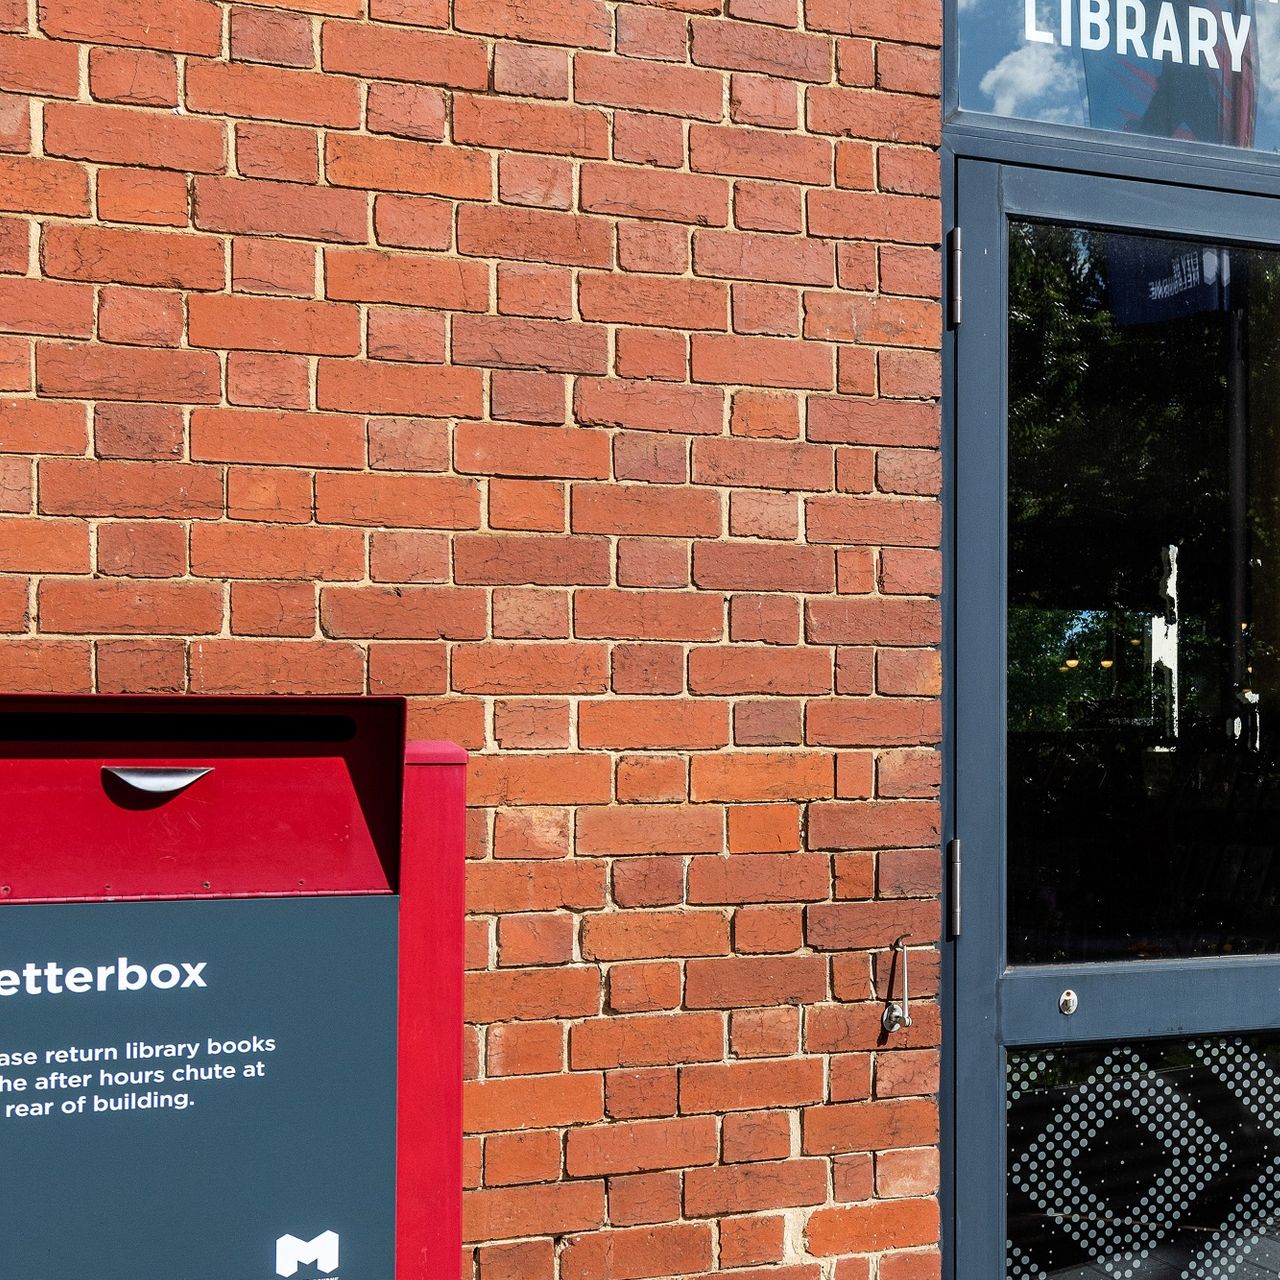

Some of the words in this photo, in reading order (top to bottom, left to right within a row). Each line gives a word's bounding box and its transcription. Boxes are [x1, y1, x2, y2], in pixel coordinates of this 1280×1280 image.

[45, 1046, 118, 1064] return
[126, 1042, 201, 1059] library
[207, 1035, 276, 1055] books
[35, 1072, 93, 1090] after
[99, 1069, 165, 1086] hours
[172, 1064, 237, 1082] chute
[243, 1061, 266, 1078] at
[5, 1102, 55, 1118] rear
[61, 1096, 87, 1114] of
[93, 1091, 195, 1112] building.
